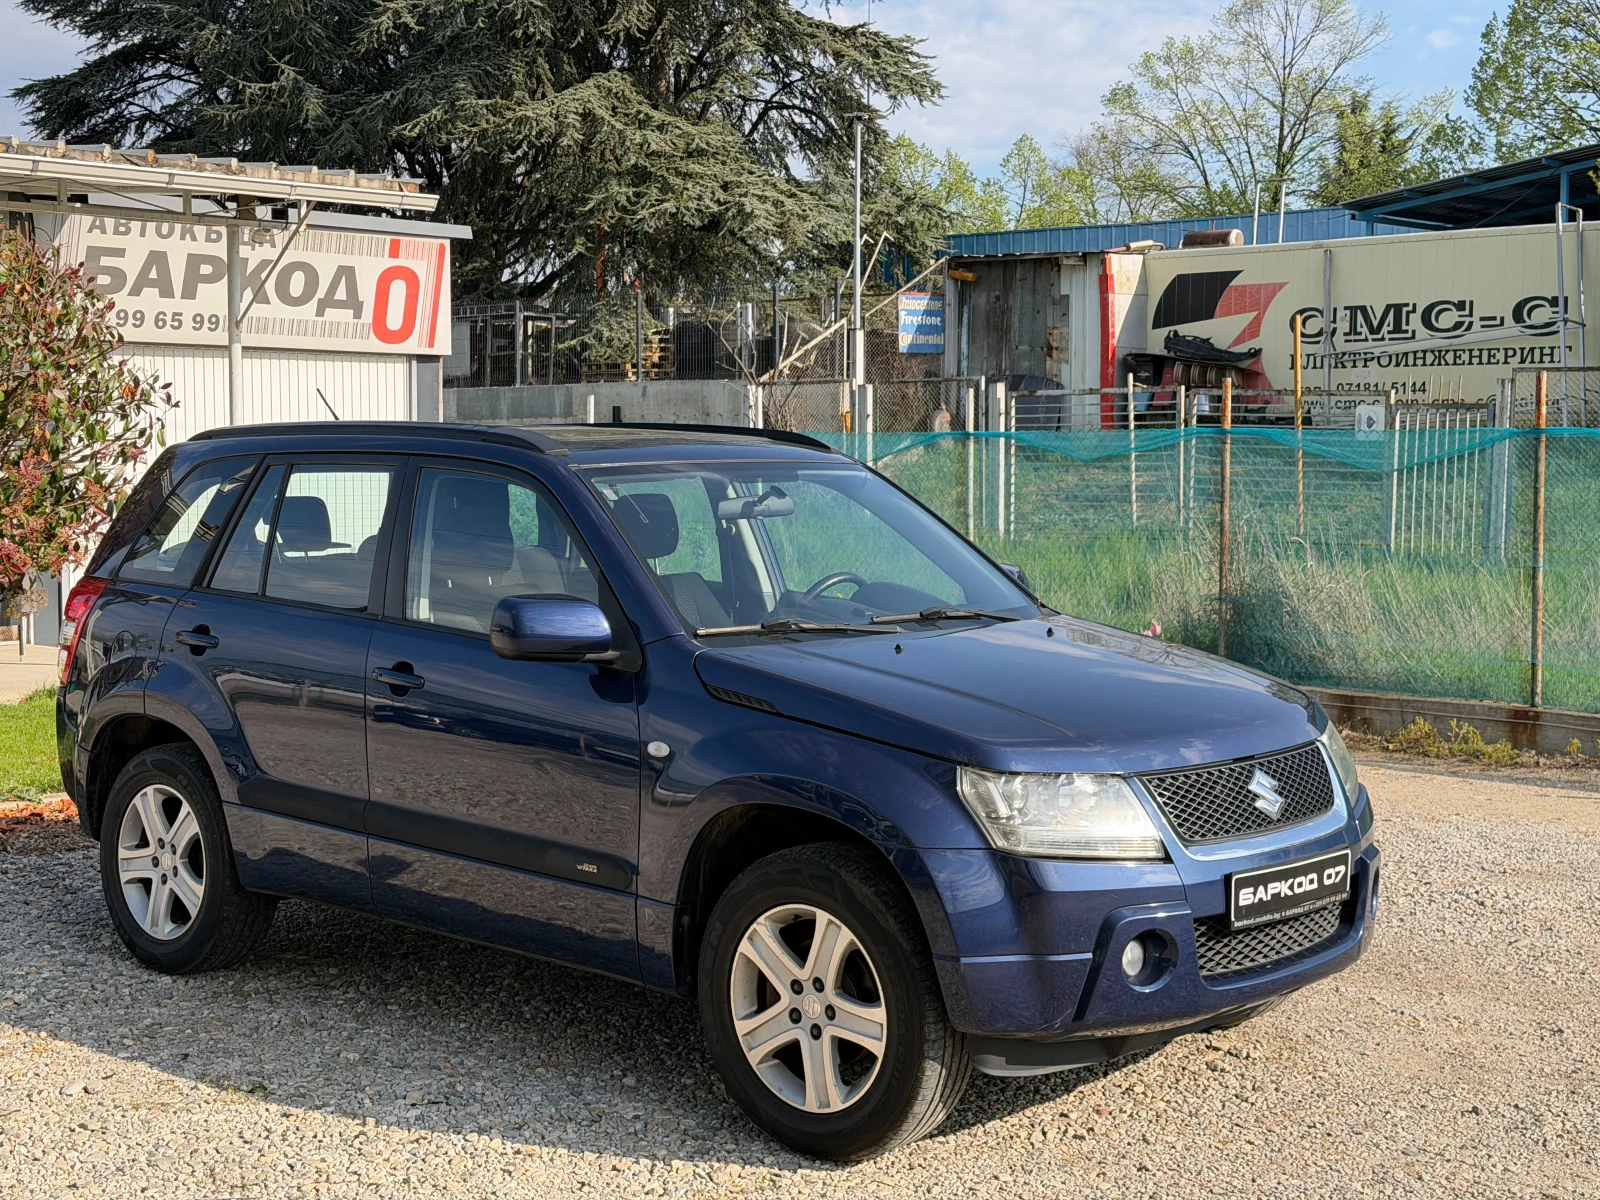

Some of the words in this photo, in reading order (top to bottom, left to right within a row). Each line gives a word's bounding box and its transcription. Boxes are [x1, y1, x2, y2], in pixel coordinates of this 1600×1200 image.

[81, 245, 365, 320] БАРКОД
[115, 308, 145, 329] 99
[154, 310, 184, 331] 65
[191, 312, 221, 333] 99
[900, 311, 942, 326] Firestone
[899, 332, 944, 346] Continental
[1391, 380, 1427, 396] 5144
[1239, 872, 1318, 907] БАРКОД
[1323, 865, 1346, 886] 07
